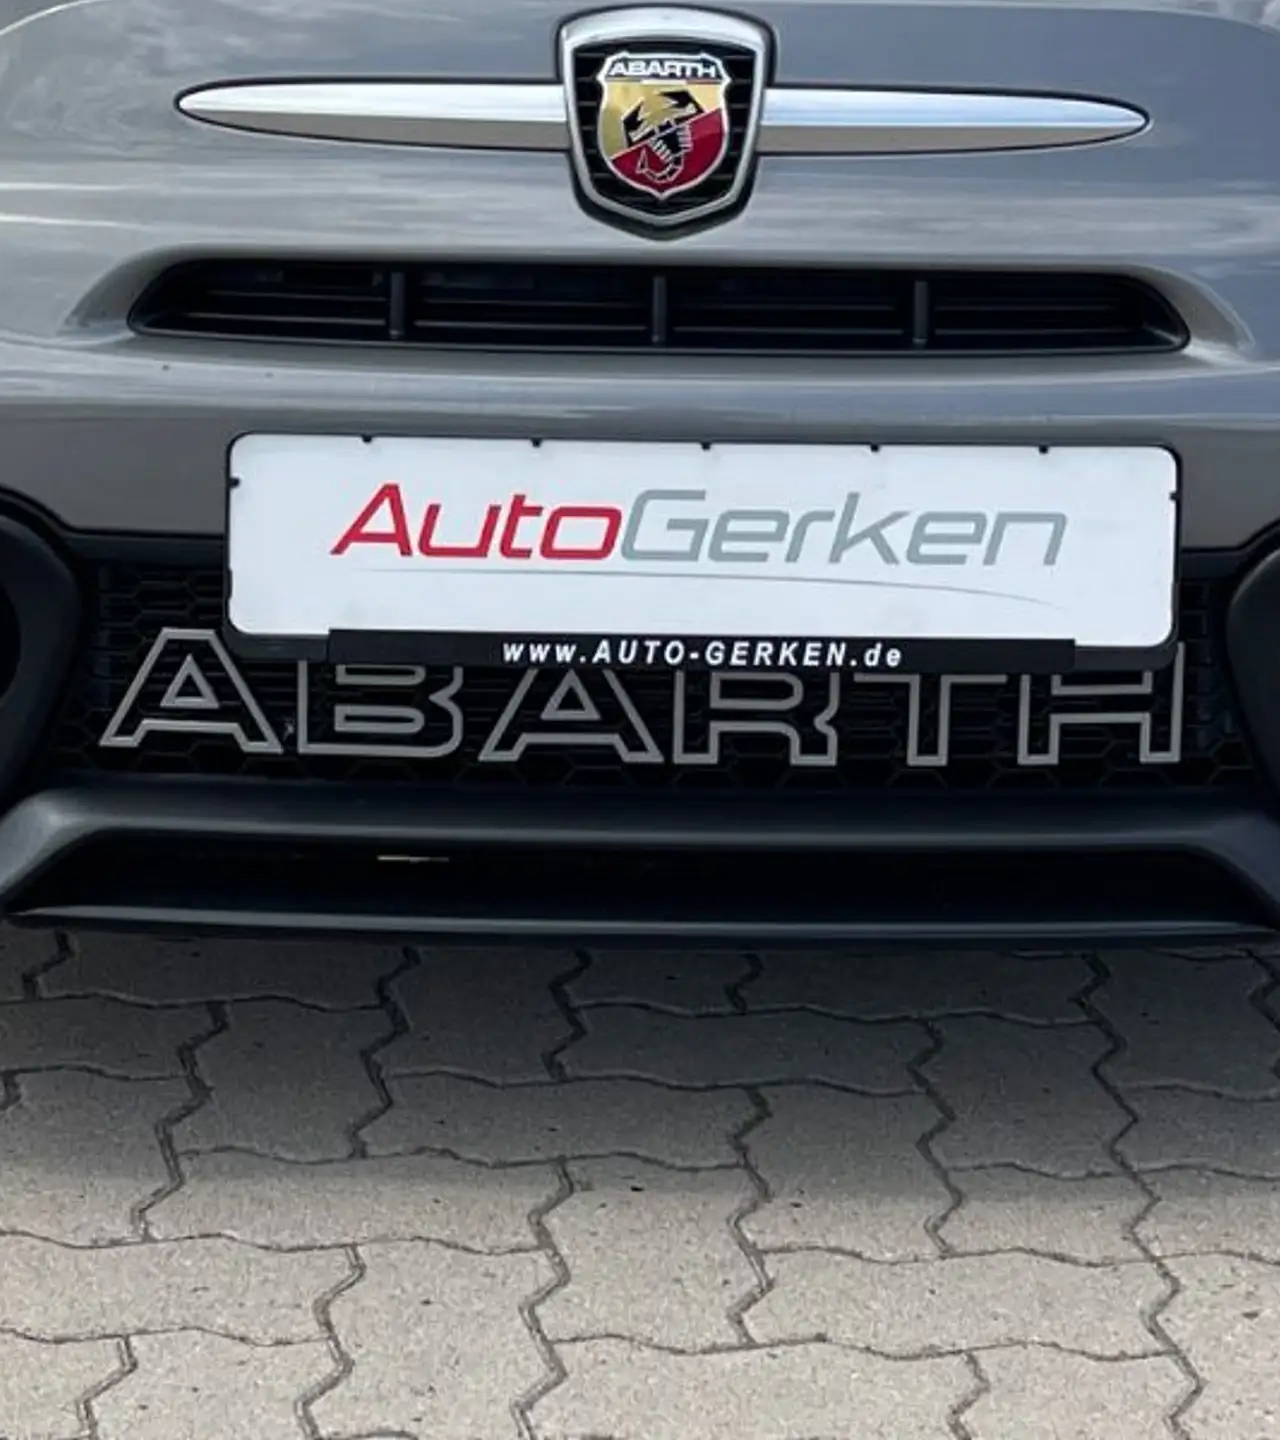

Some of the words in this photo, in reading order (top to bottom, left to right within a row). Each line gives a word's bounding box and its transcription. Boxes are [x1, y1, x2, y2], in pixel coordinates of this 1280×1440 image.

[608, 60, 716, 78] ABARTH
[330, 482, 1068, 567] AutoGerken
[502, 640, 902, 668] www.AUTO-GERKEN.de
[99, 626, 1185, 766] ABARTH
